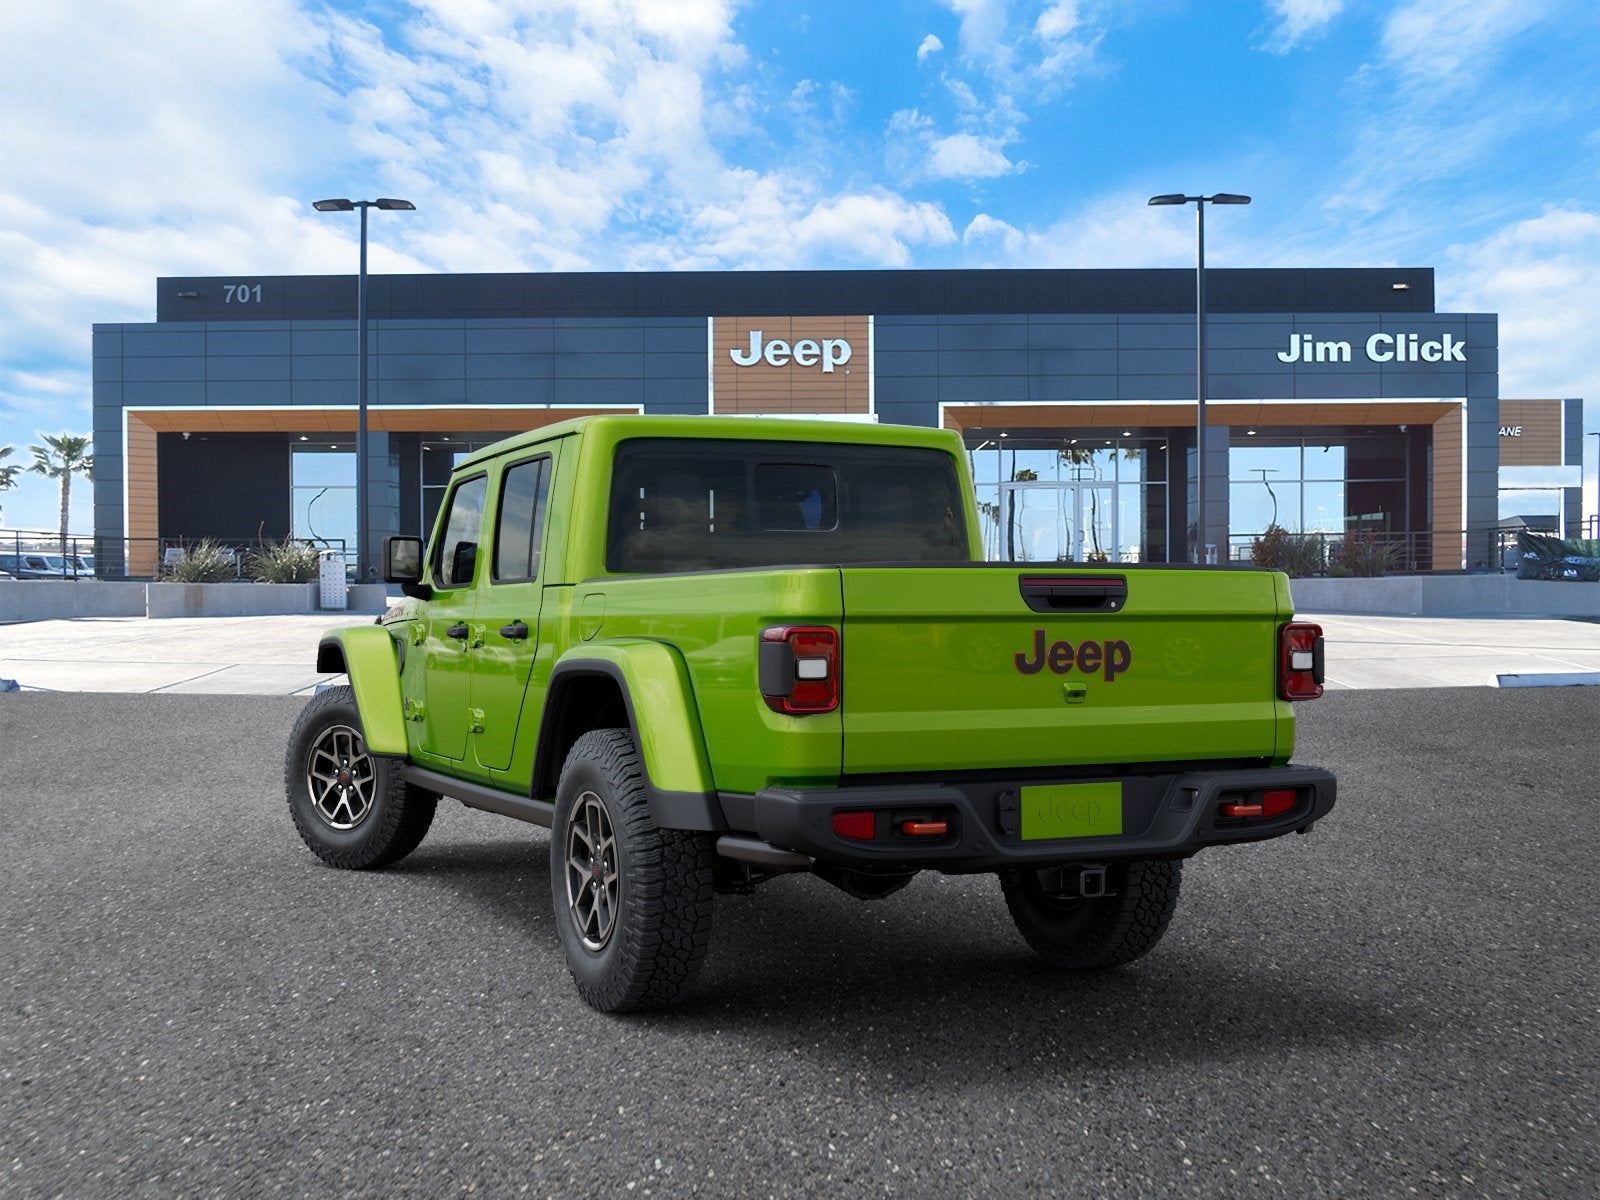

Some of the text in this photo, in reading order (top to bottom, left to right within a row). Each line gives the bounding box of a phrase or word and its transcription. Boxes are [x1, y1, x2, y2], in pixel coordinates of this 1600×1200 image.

[223, 284, 262, 303] 701
[729, 329, 852, 373] Jeep
[1277, 333, 1467, 363] Jim Click
[1014, 628, 1132, 682] Jeep
[1032, 794, 1104, 826] Jeep
